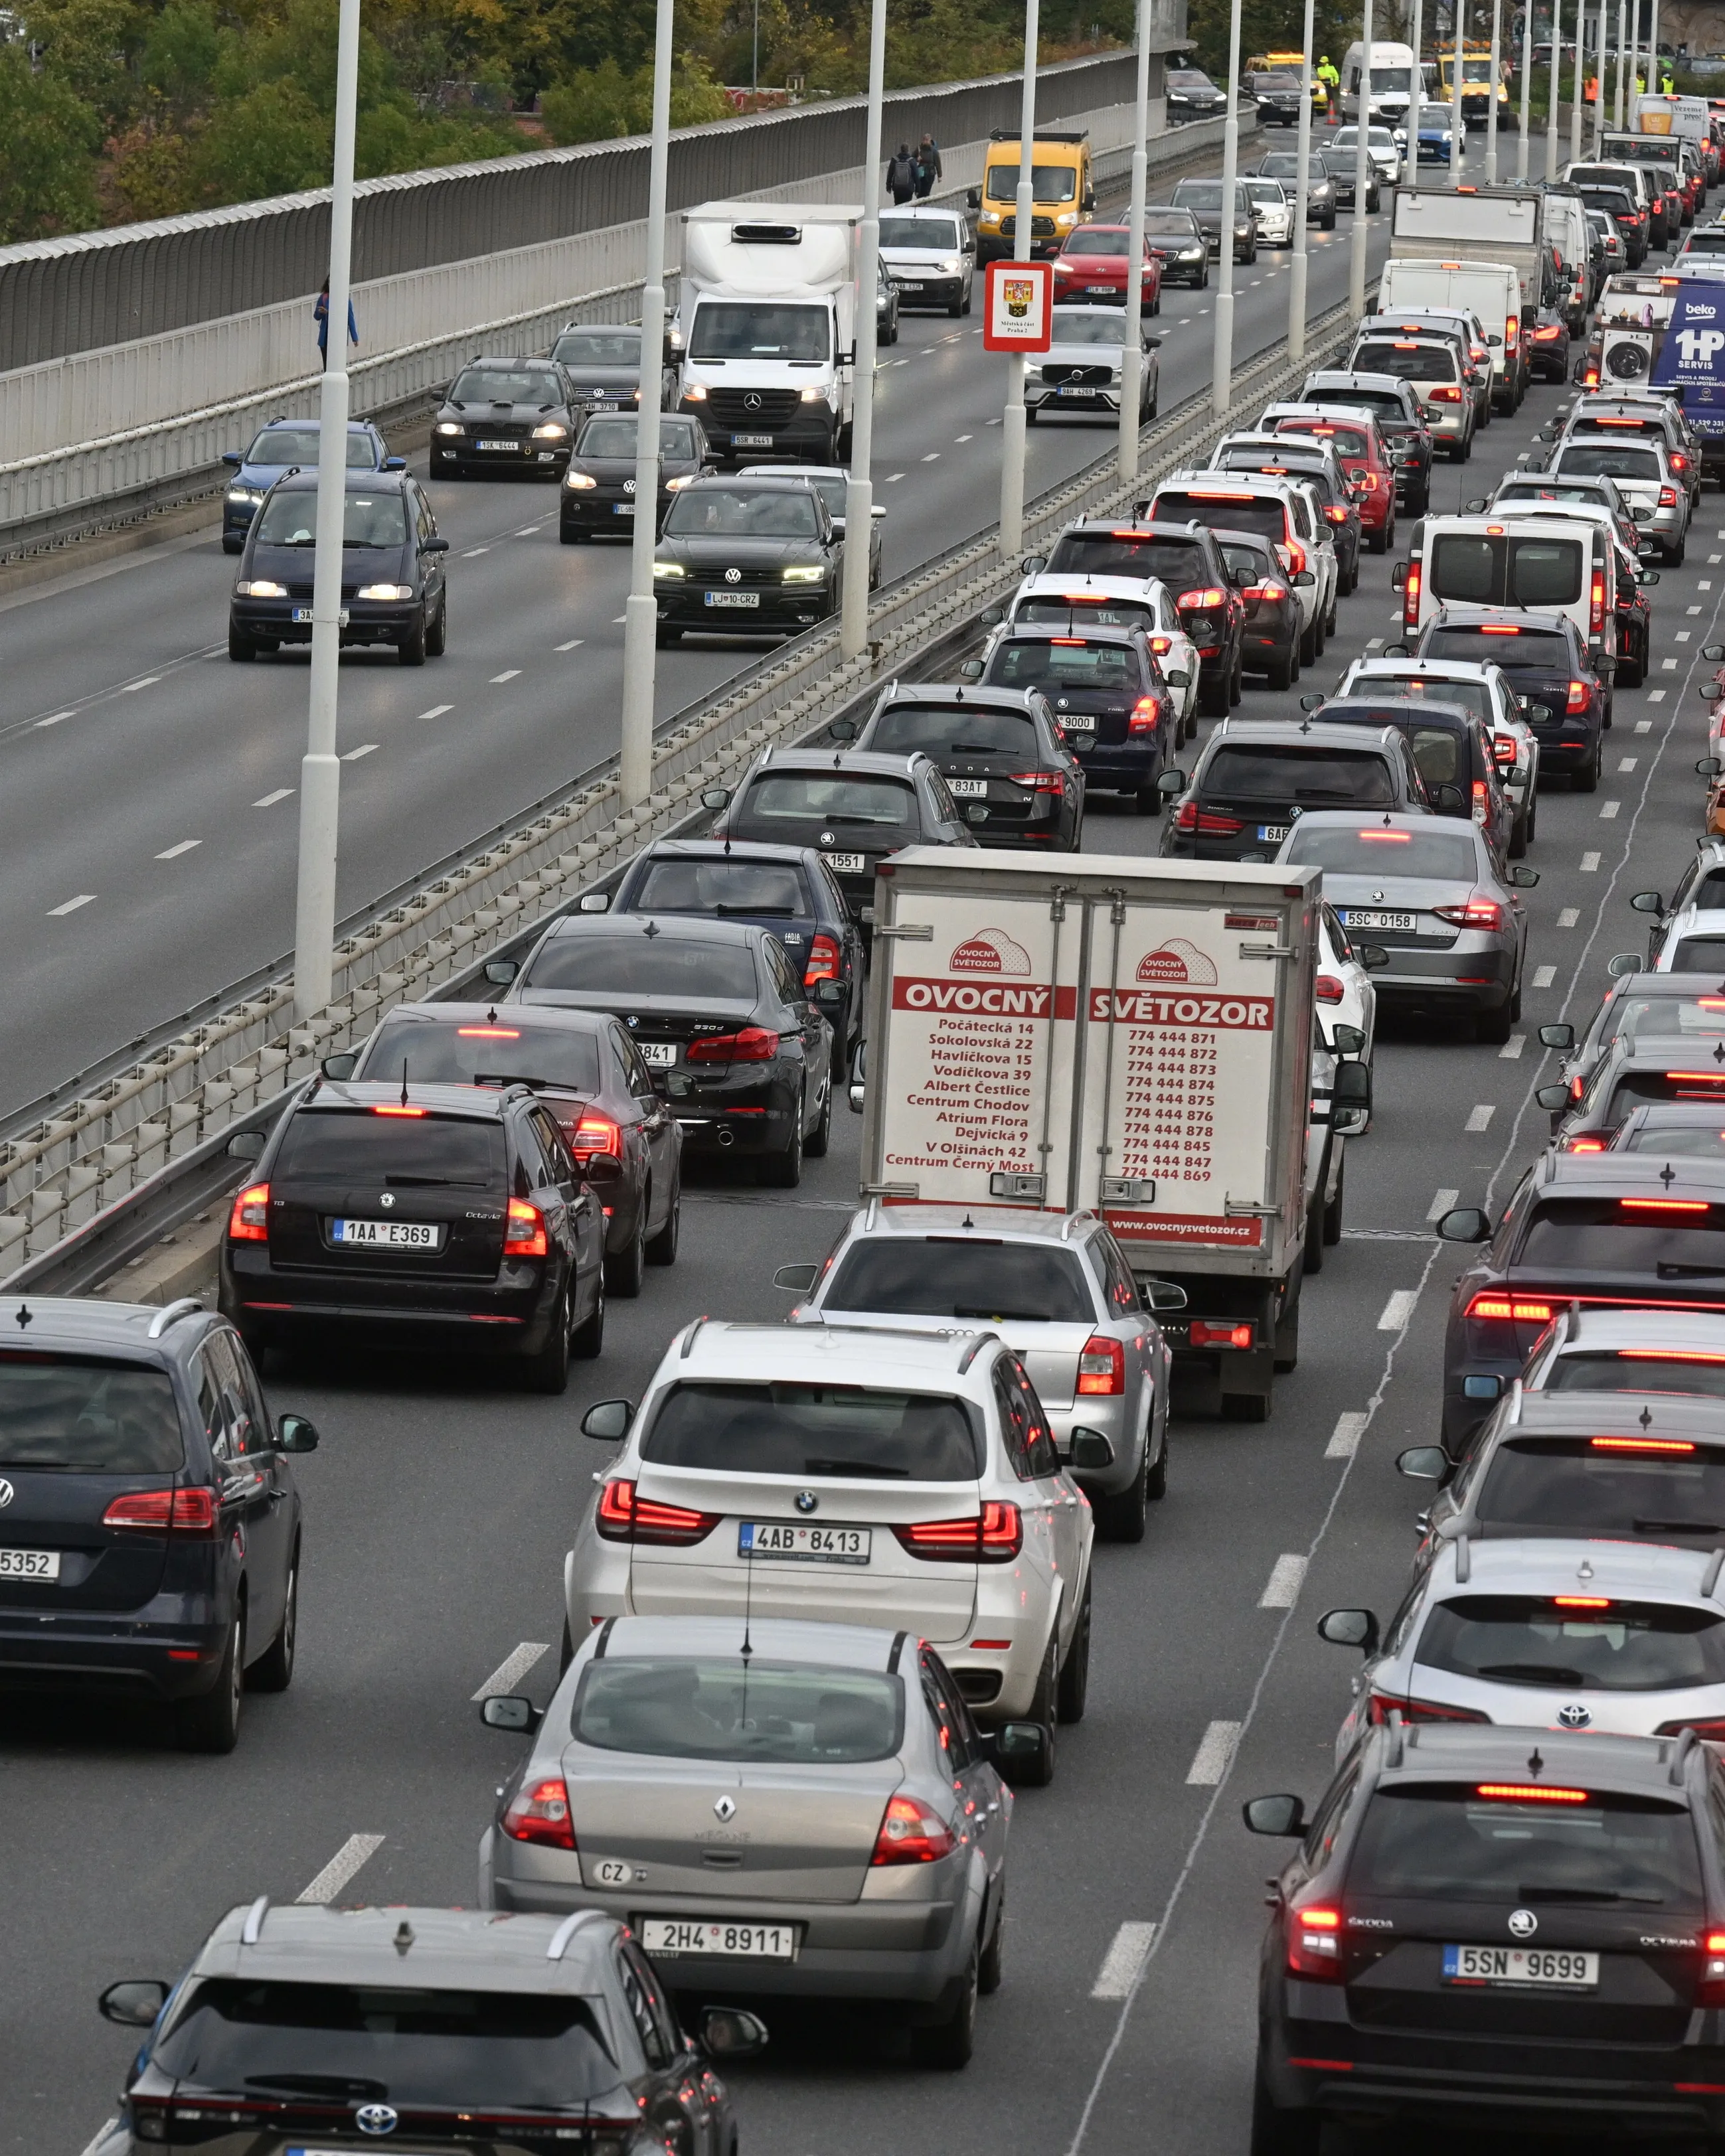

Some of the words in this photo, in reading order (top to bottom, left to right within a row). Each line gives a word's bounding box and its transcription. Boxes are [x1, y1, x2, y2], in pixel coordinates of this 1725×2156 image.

[1685, 303, 1716, 315] beko
[1678, 360, 1713, 370] SERVIS
[713, 594, 723, 603] LJ
[730, 595, 756, 603] 10-CRZ
[300, 610, 313, 620] 3A
[1065, 716, 1090, 728] 9000
[955, 781, 982, 793] 83AT
[831, 854, 859, 868] 1551
[1349, 913, 1370, 925] 5SC
[1380, 915, 1410, 927] 0158
[959, 949, 996, 958] OVOCNÝ
[954, 958, 1000, 968] SVĚTOZOR
[1145, 959, 1183, 968] OVOCNÝ
[1140, 968, 1187, 978] SVĚTOZOR
[906, 984, 1050, 1014] OVOCNÝ
[1094, 992, 1269, 1026] SVĚTOZOR
[939, 1019, 1012, 1033] Počátecká
[1019, 1023, 1034, 1034] 14
[929, 1034, 1011, 1049] Sokolovská
[1015, 1039, 1033, 1050] 22
[1129, 1030, 1155, 1041] 774
[1159, 1032, 1187, 1043] 444
[1191, 1033, 1216, 1044] 871
[931, 1049, 1011, 1064] Havlíčkova
[1017, 1055, 1032, 1065] 15
[1128, 1045, 1154, 1057] 774
[1158, 1047, 1186, 1058] 444
[1190, 1048, 1217, 1060] 872
[934, 1065, 1009, 1079] Vodičkova
[1013, 1069, 1031, 1081] 39
[1127, 1061, 1153, 1072] 774
[1157, 1062, 1185, 1073] 444
[1189, 1064, 1216, 1075] 873
[924, 1080, 971, 1093] Albert
[975, 1081, 1030, 1096] Čestlice
[1127, 1076, 1152, 1087] 774
[1157, 1078, 1184, 1089] 444
[1189, 1079, 1214, 1091] 874
[907, 1094, 969, 1108] Centrum
[974, 1099, 1030, 1112] Chodov
[1126, 1092, 1151, 1103] 774
[1156, 1093, 1183, 1105] 444
[1187, 1095, 1214, 1106] 875
[936, 1112, 987, 1125] Atrium
[991, 1115, 1028, 1127] Flora
[1125, 1107, 1151, 1118] 774
[1155, 1109, 1183, 1120] 444
[1187, 1111, 1213, 1122] 876
[955, 1126, 1015, 1141] Dejvická
[1019, 1132, 1028, 1142] 9
[1124, 1122, 1150, 1134] 774
[1154, 1124, 1182, 1135] 444
[1186, 1126, 1213, 1137] 878
[926, 1142, 938, 1152] V
[941, 1142, 1004, 1157] Olšinách
[1008, 1147, 1027, 1158] 42
[1123, 1138, 1149, 1149] 774
[1153, 1139, 1180, 1150] 444
[1184, 1140, 1210, 1152] 845
[886, 1154, 948, 1168] Centrum
[952, 1155, 995, 1173] Černý
[999, 1160, 1034, 1172] Most
[1123, 1154, 1148, 1164] 774
[1153, 1155, 1180, 1166] 444
[1185, 1156, 1211, 1168] 847
[1121, 1167, 1147, 1178] 774
[1151, 1168, 1179, 1180] 444
[1183, 1170, 1211, 1182] 869
[465, 1211, 501, 1220] Octavia
[349, 1223, 376, 1241] 1AA
[390, 1225, 430, 1244] E369
[1112, 1220, 1250, 1236] www.ovocnysvetozor.cz
[758, 1527, 794, 1549] 4AB
[811, 1531, 861, 1553] 8413
[0, 1552, 50, 1574] 5352
[602, 1863, 623, 1882] CZ
[1348, 1916, 1394, 1928] ŠKODA
[663, 1924, 704, 1949] 2H4
[724, 1928, 781, 1952] 8911
[1464, 1950, 1509, 1975] 5SN
[1527, 1953, 1586, 1979] 9699
